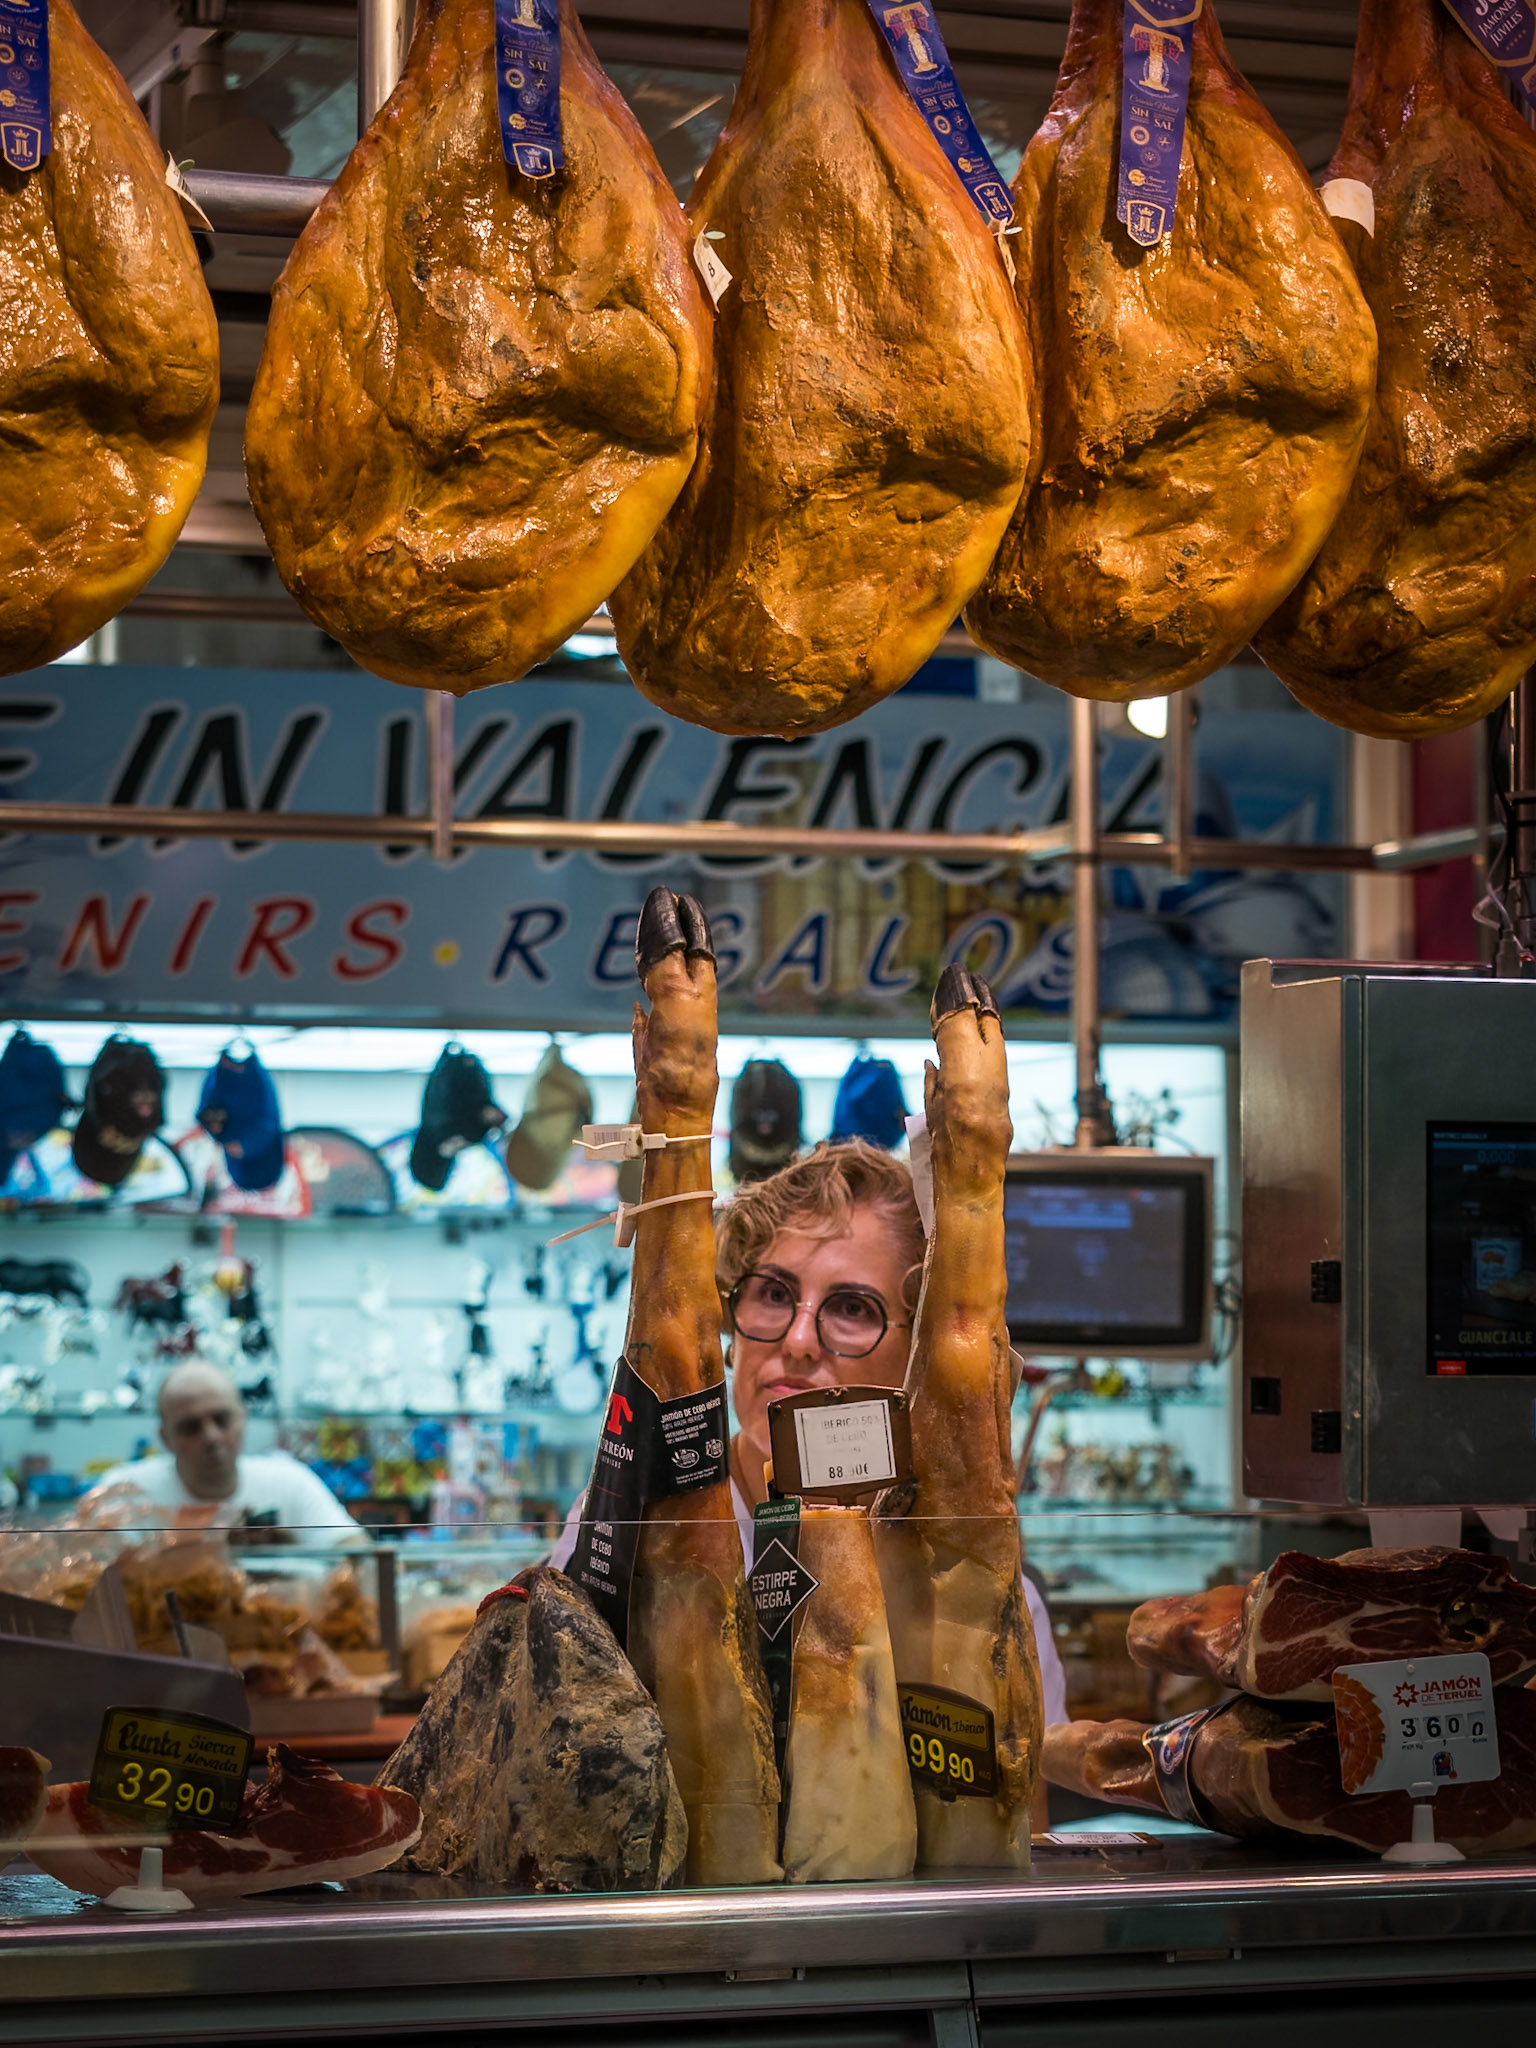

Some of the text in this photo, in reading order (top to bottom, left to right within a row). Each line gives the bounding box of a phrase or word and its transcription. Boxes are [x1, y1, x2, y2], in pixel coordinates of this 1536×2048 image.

[0, 26, 11, 35] IN
[1489, 10, 1523, 47] JUVILES
[17, 35, 39, 48] SAL
[504, 47, 523, 59] SIN
[528, 58, 549, 72] SAL
[923, 96, 938, 108] SIN
[942, 99, 959, 110] SAL
[1131, 106, 1149, 117] SIN
[1154, 119, 1174, 131] SAL
[97, 706, 321, 850] IN
[1458, 1331, 1533, 1345] GUANCIALE
[601, 1438, 634, 1461] RREÓN
[592, 1537, 612, 1556] DE CEBO
[752, 1570, 798, 1592] ESTIRPE
[754, 1590, 792, 1610] NEGRA
[1421, 1675, 1481, 1693] JAMÓN
[1421, 1693, 1435, 1702] DE
[1437, 1689, 1482, 1701] TERUEL
[901, 1696, 952, 1732] Jamón
[118, 1720, 236, 1759] Punta Sierra
[183, 1752, 238, 1773] Nevada
[910, 1733, 974, 1783] 99 90
[117, 1762, 214, 1815] 32 90
